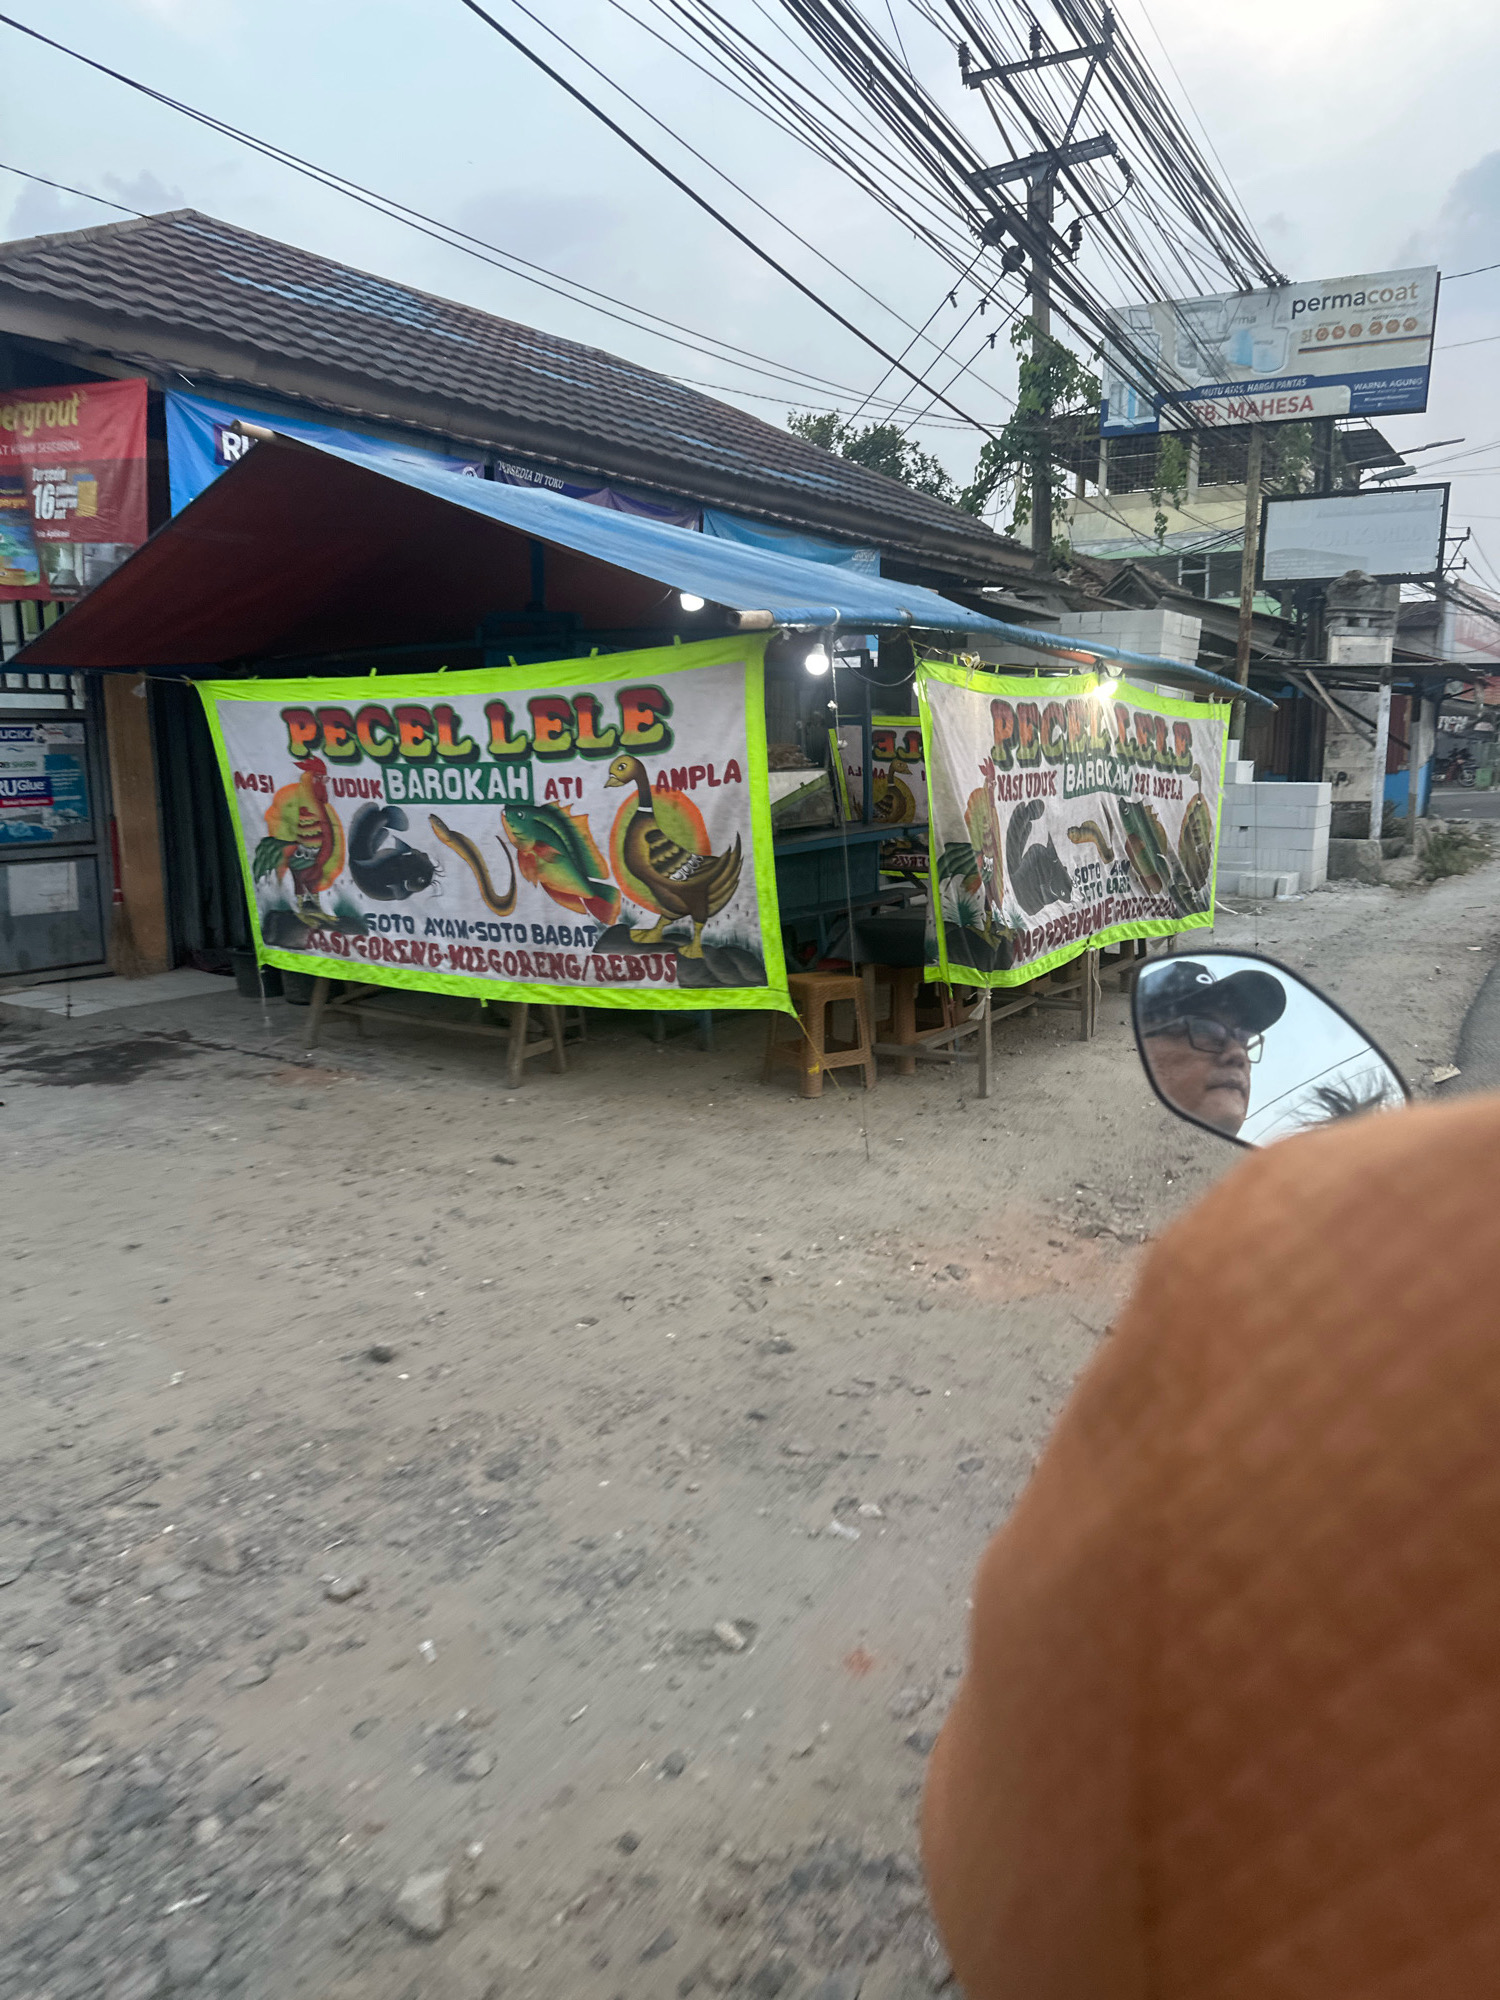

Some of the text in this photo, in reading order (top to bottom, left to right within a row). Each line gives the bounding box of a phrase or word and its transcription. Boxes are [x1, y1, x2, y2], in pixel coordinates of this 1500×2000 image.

[1291, 282, 1419, 320] permacoat
[1247, 381, 1275, 393] HARGA
[1275, 377, 1307, 390] PANTAS
[1354, 380, 1387, 391] WARNA
[1389, 377, 1424, 388] AGUNG
[0, 391, 81, 437] ergrout
[1227, 395, 1315, 419] MAHESA
[497, 460, 533, 481] TERSEDIA
[534, 472, 544, 484] DI
[32, 482, 55, 519] 16
[281, 684, 675, 764] PECEL LELE
[990, 698, 1193, 774] PECEL LELE
[234, 770, 384, 799] NASI UDUK
[386, 765, 530, 801] BAROKAH
[544, 758, 742, 800] ATI AMPLA
[997, 770, 1057, 802] NASI UDUK
[1066, 758, 1130, 792] BAROKAH
[1075, 862, 1101, 886] SOTO
[305, 929, 351, 957] NASI
[365, 913, 415, 934] SOTO
[532, 923, 598, 948] BABAT
